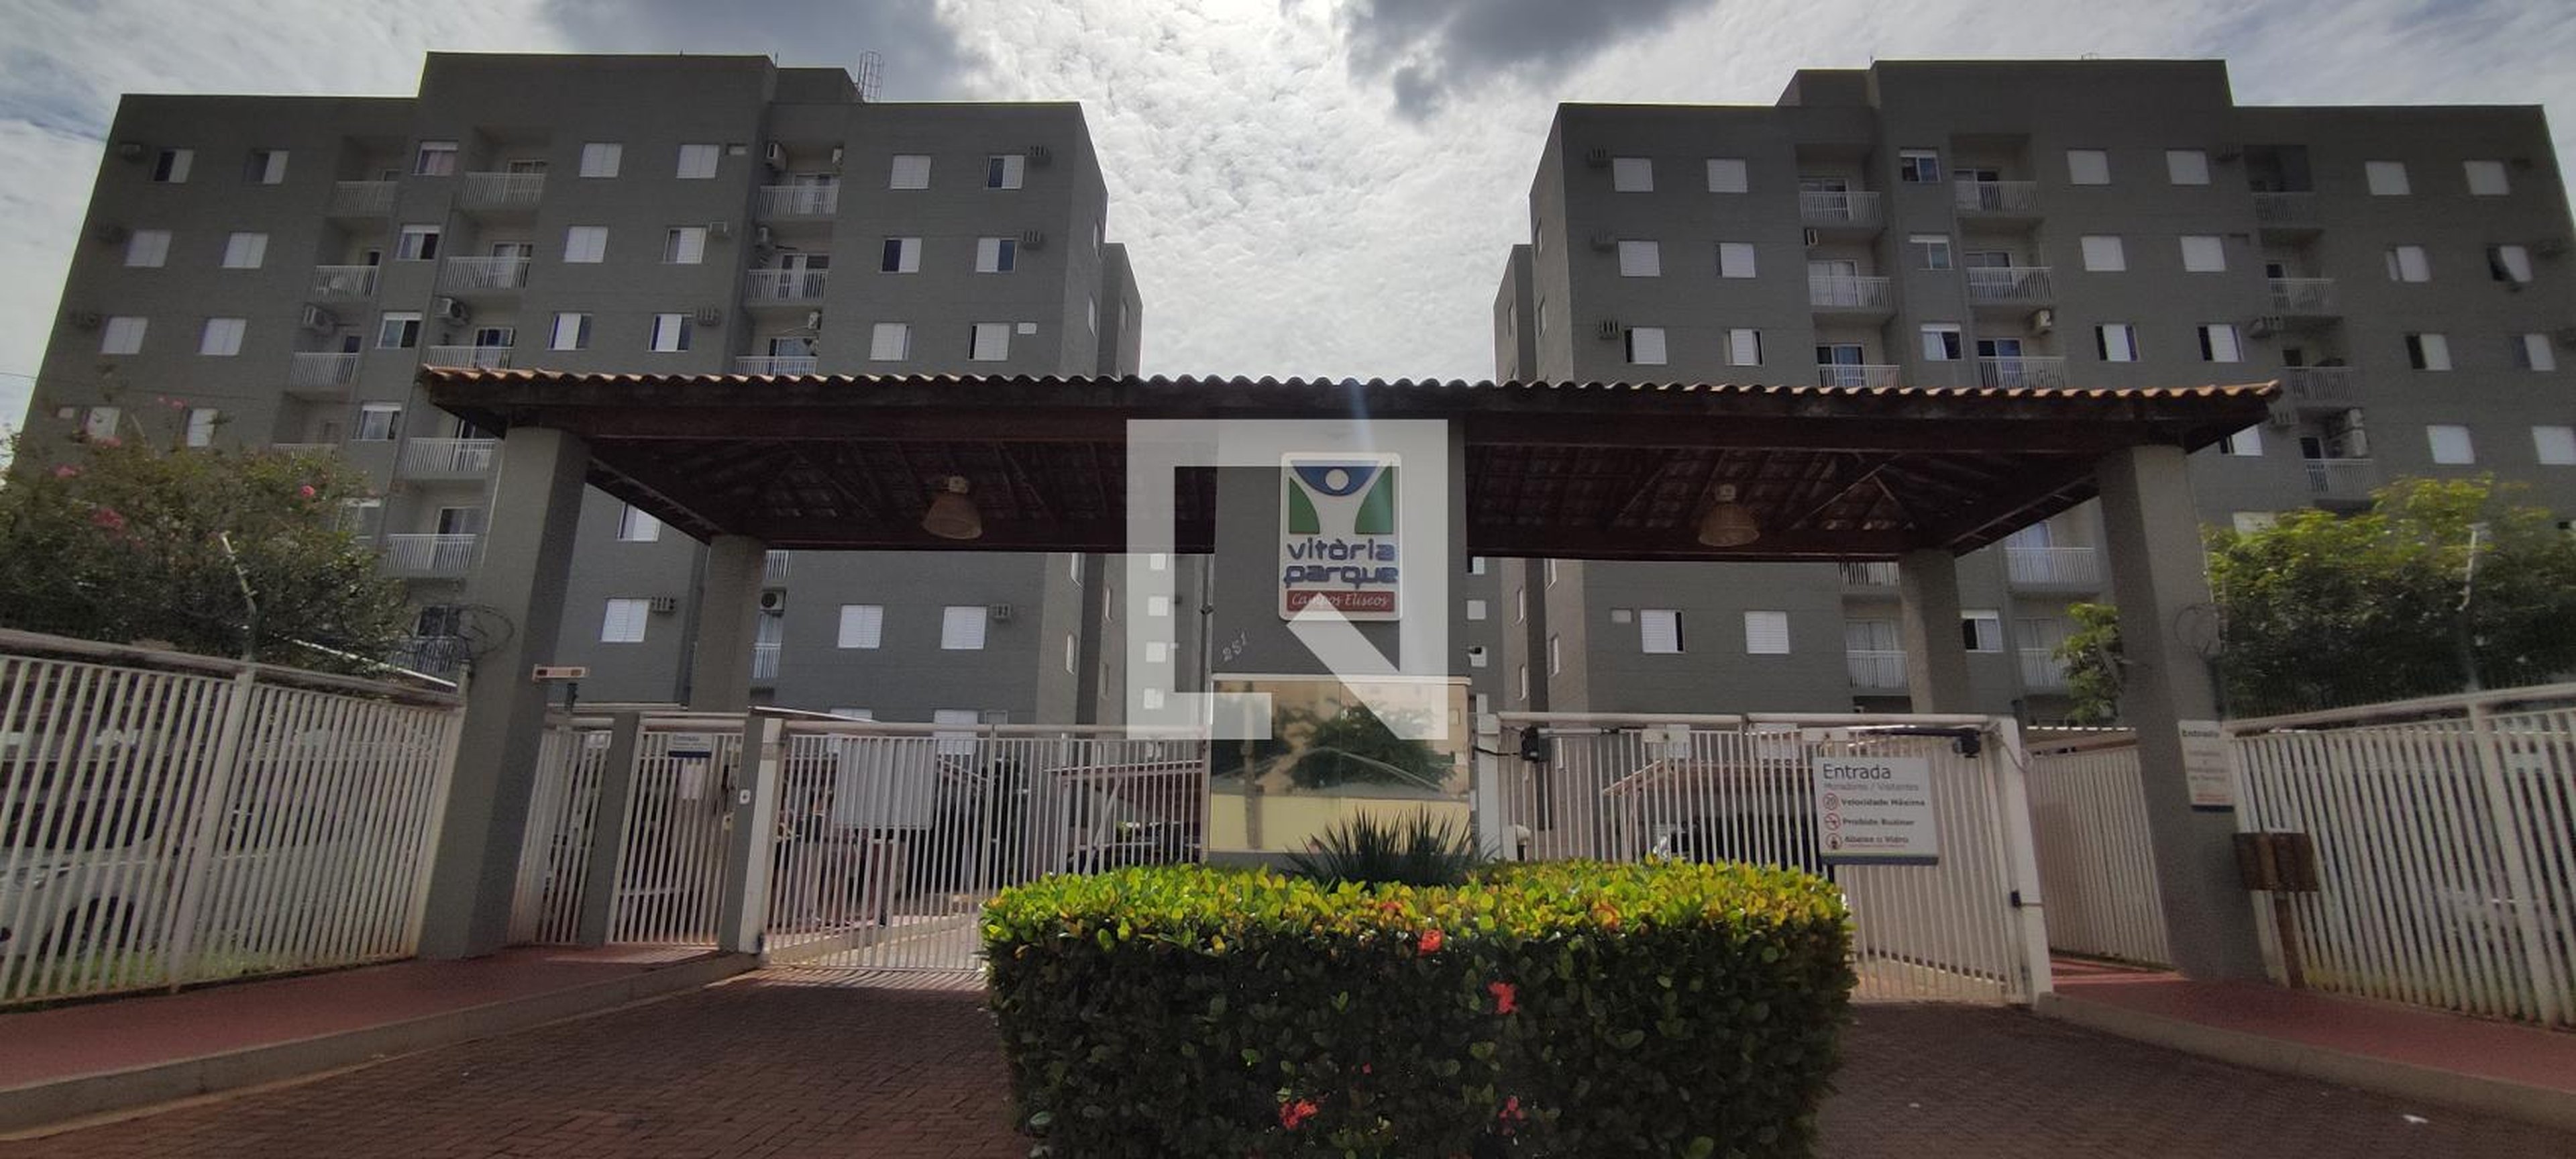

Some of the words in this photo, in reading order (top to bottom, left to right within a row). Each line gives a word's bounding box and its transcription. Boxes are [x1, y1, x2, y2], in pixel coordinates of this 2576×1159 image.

[1283, 565, 1399, 589] parque
[1291, 593, 1340, 606] Caos
[1823, 763, 1891, 780] Entrada
[1841, 798, 1888, 806] Velocidade
